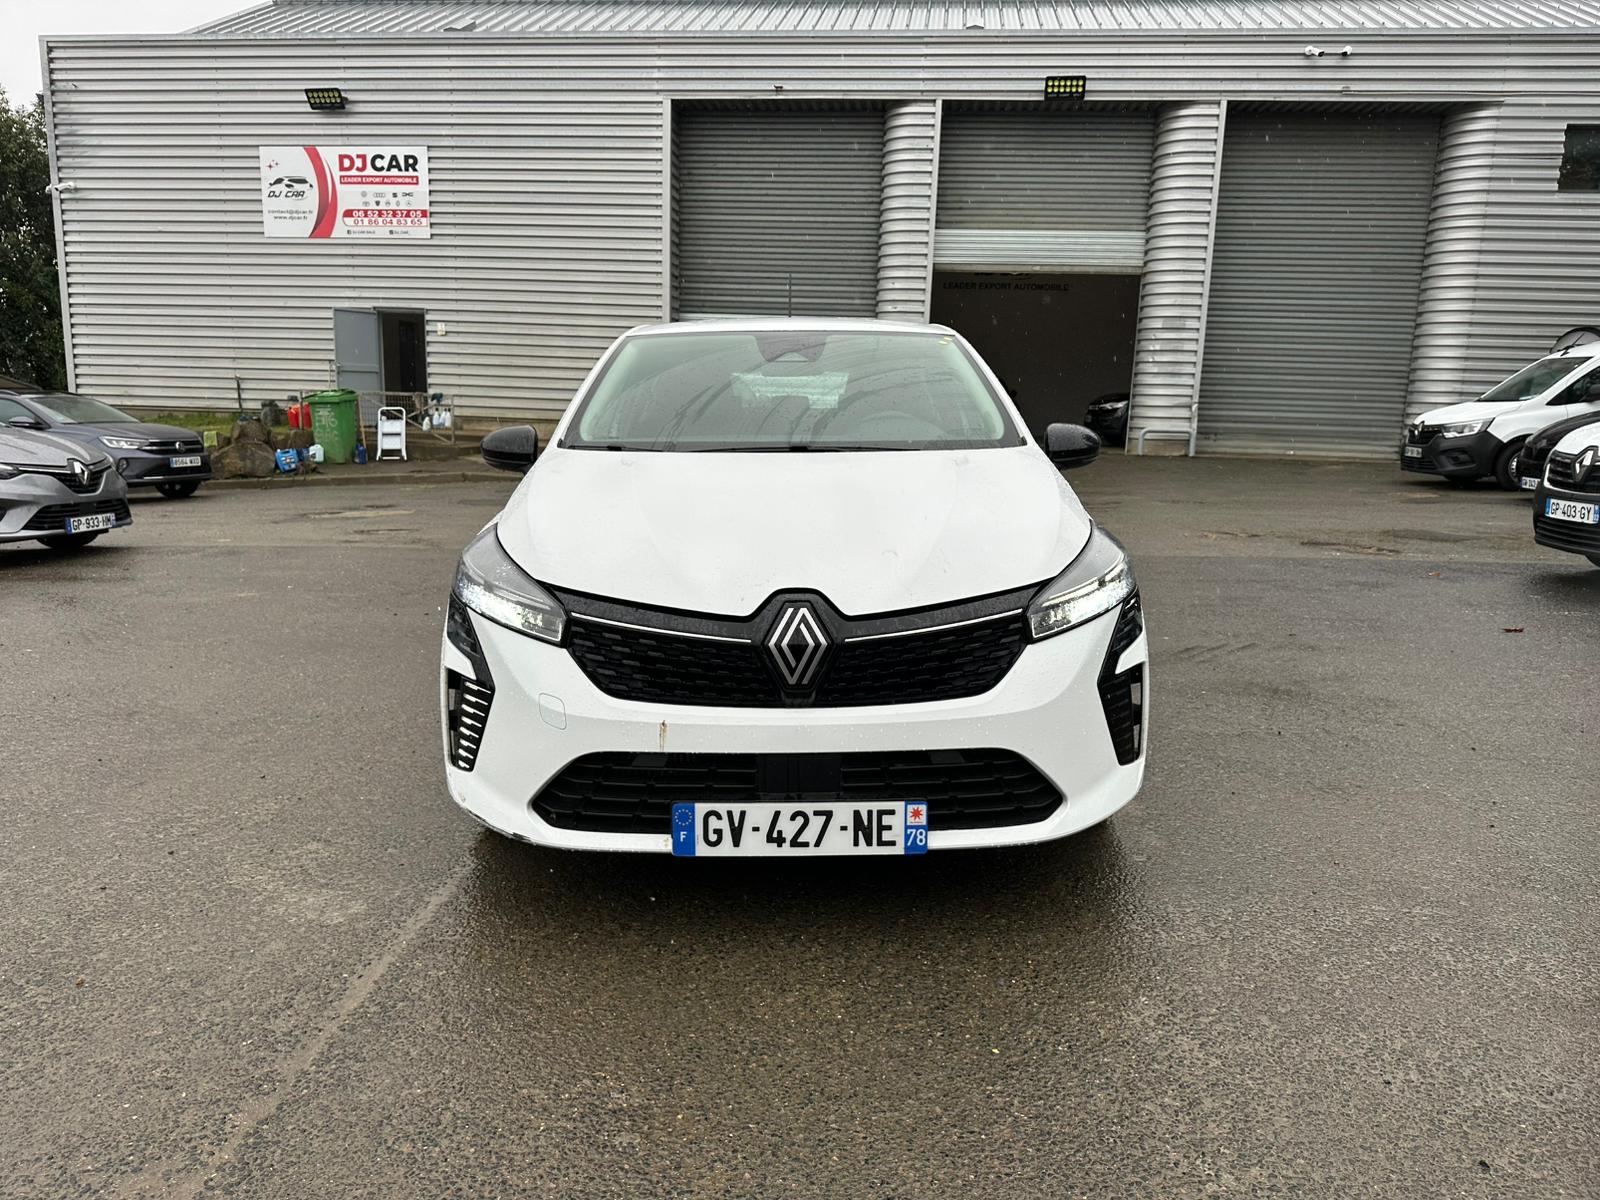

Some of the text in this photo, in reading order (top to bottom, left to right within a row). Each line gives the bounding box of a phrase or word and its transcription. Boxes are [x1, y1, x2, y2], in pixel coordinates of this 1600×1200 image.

[338, 154, 418, 172] DJ CAR
[267, 190, 306, 198] DJ CAR
[943, 282, 1069, 292] LEADER EXPORT AUTOMOBILE
[1550, 501, 1592, 521] GP-403-GY
[72, 515, 112, 531] GP-933-HM
[680, 831, 687, 842] F
[702, 809, 897, 848] GV-427-NE
[907, 829, 926, 846] 78
